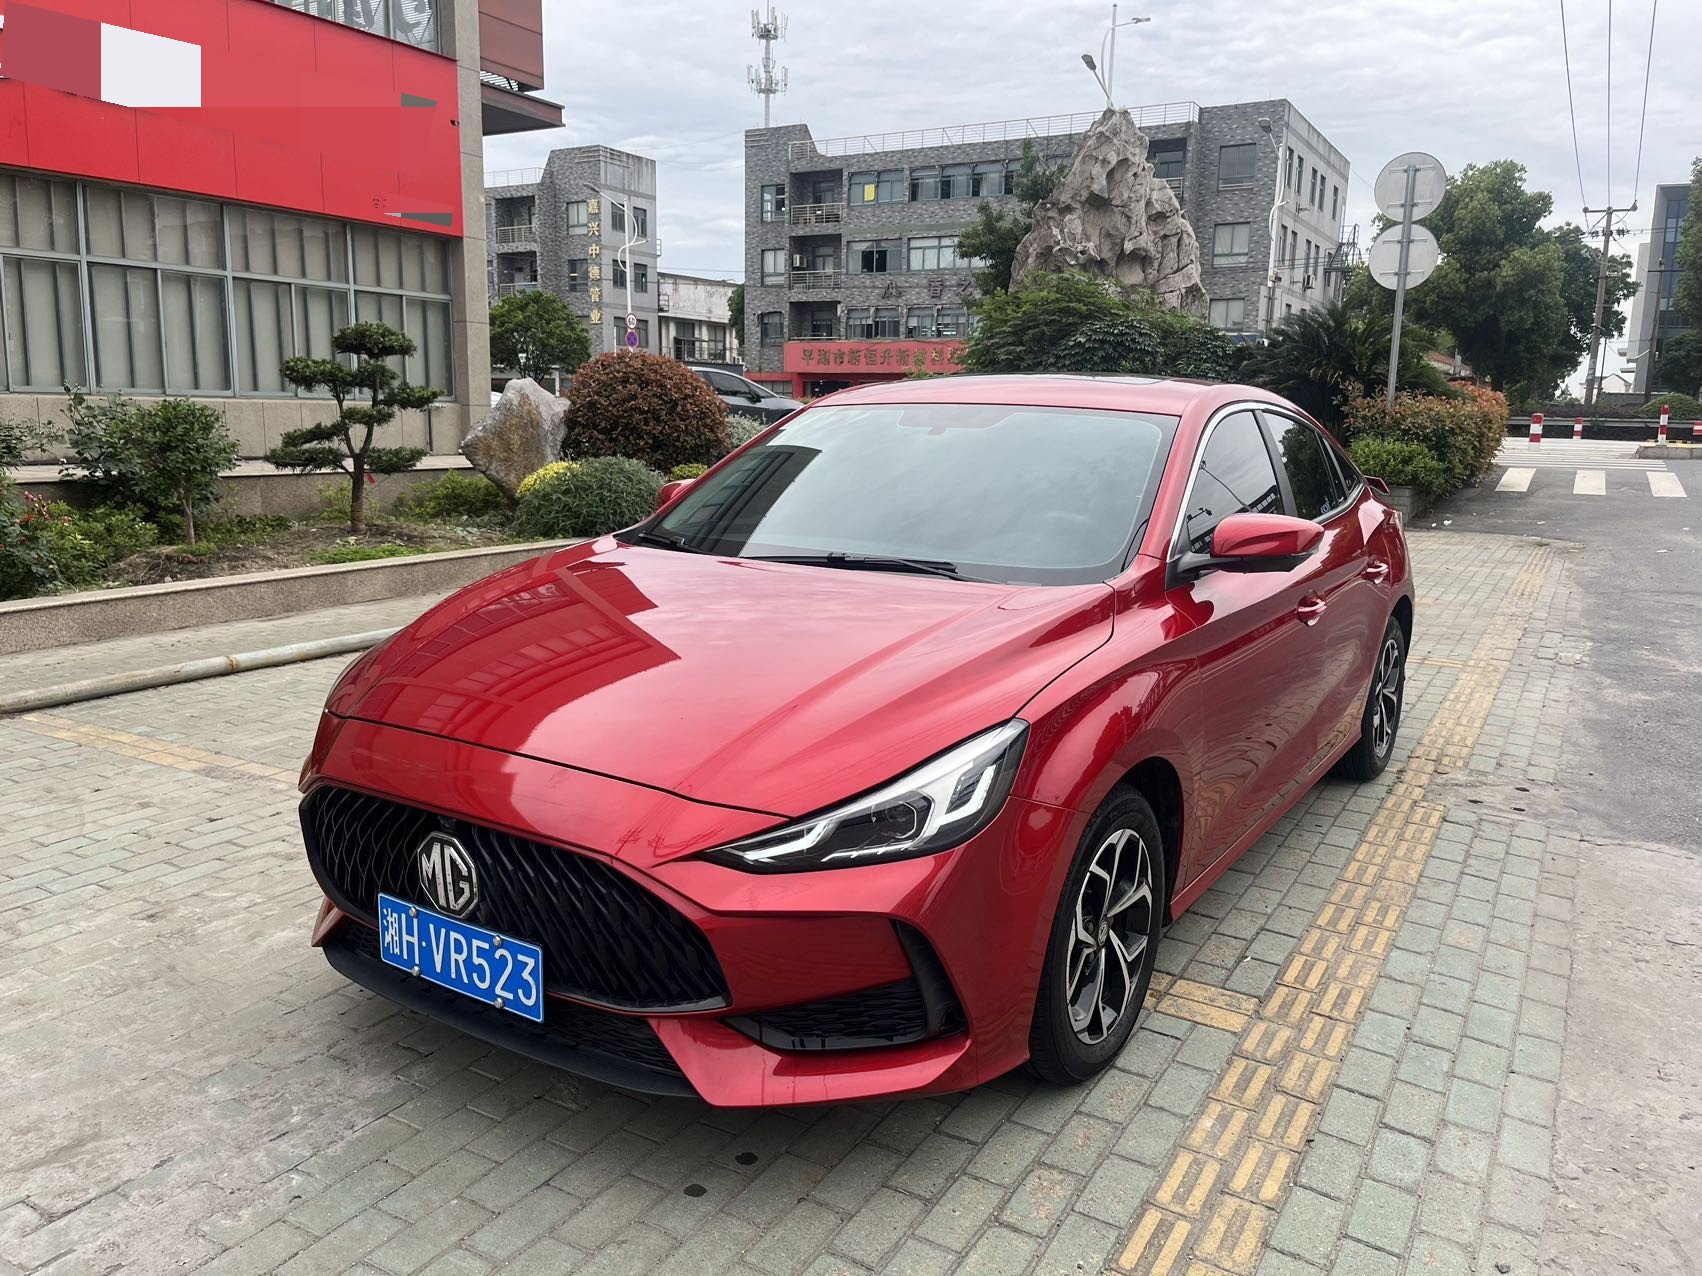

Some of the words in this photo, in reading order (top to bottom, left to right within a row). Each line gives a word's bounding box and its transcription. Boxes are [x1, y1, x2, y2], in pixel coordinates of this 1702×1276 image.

[587, 198, 602, 325] 嘉兴中德管业
[421, 842, 470, 912] MG
[383, 907, 538, 1008] 湘H·VR523
